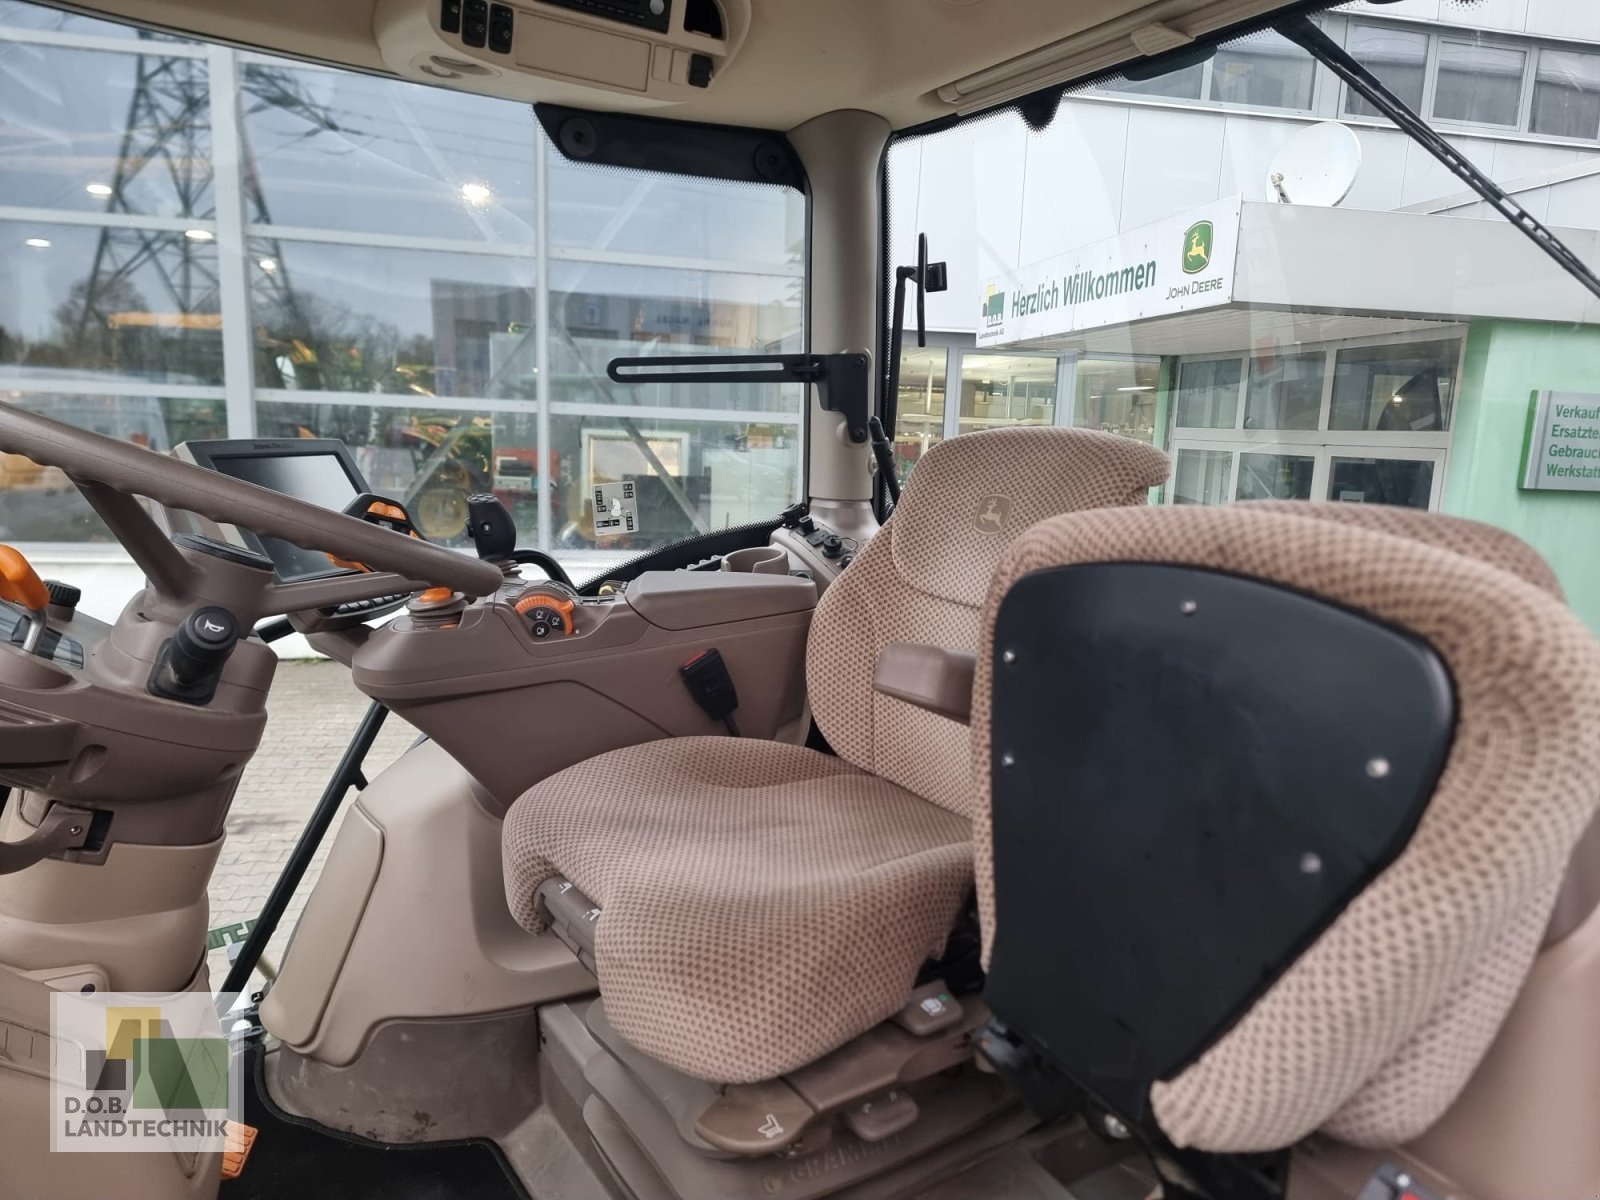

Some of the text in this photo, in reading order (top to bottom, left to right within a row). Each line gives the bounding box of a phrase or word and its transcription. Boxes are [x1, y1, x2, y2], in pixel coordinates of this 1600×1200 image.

[1011, 260, 1157, 318] Herzlich Willkommen
[1166, 277, 1223, 300] JOHN DEERE
